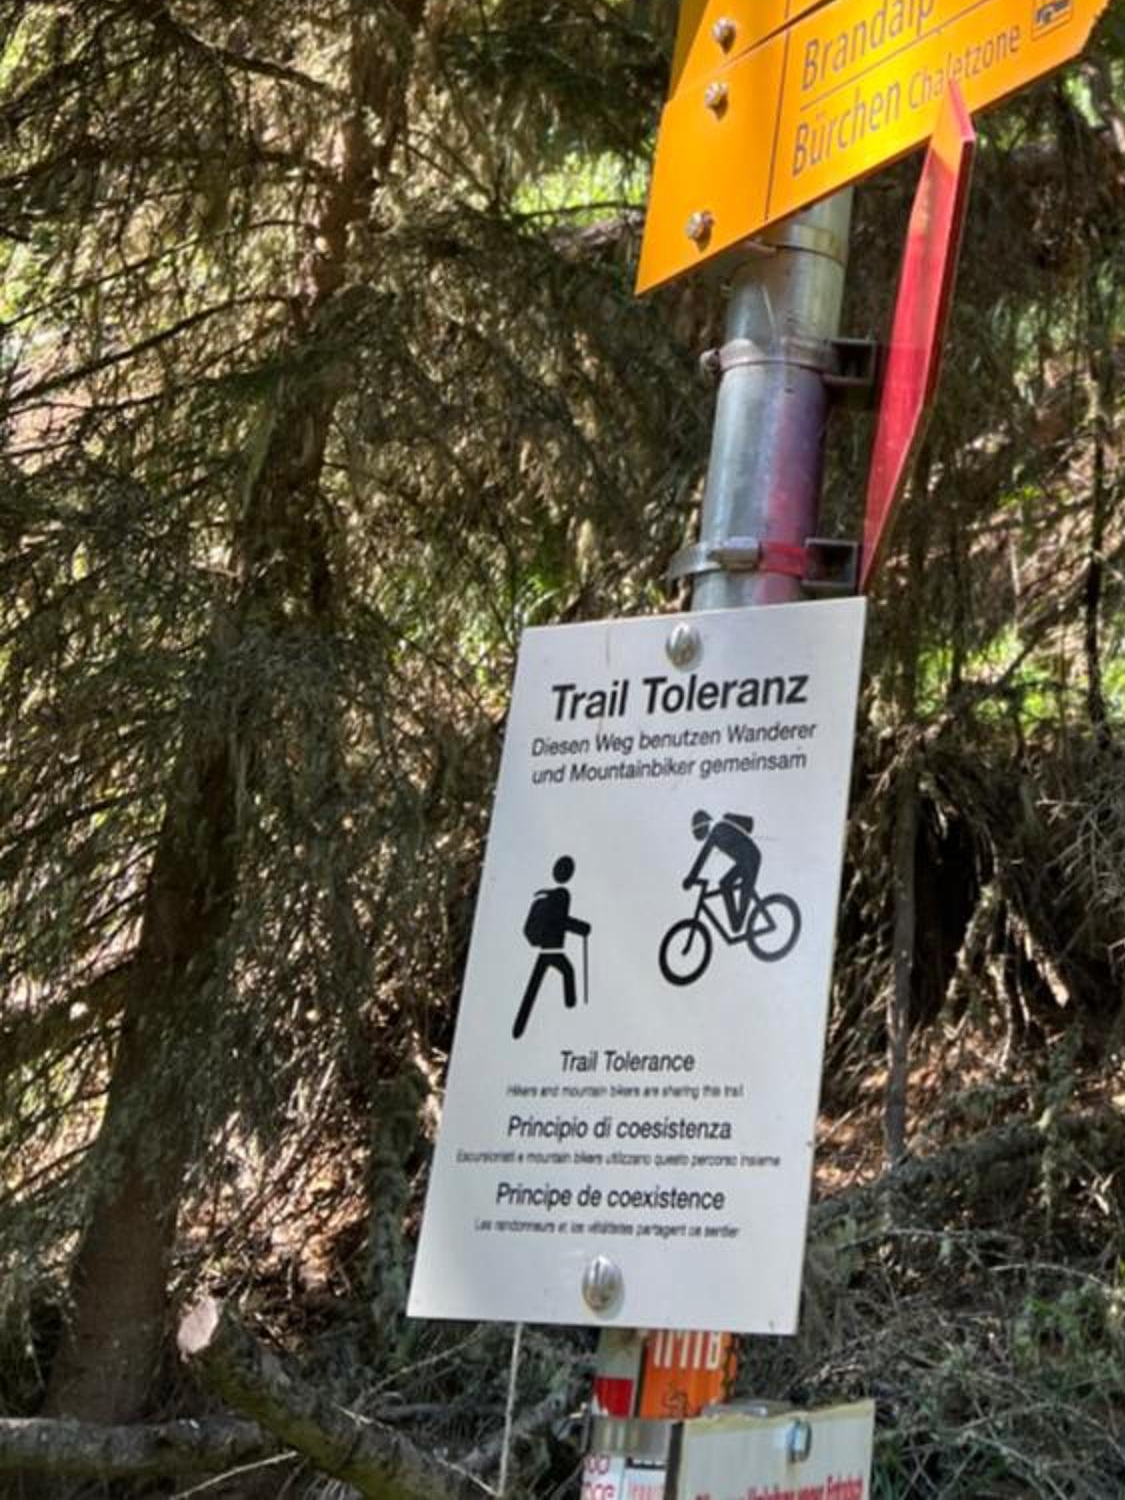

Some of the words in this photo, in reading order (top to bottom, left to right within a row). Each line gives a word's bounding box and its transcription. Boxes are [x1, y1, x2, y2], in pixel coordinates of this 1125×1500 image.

[792, 79, 901, 177] Bürchen
[908, 25, 1021, 109] Chaletzone
[551, 679, 629, 721] Trail
[643, 673, 810, 714] Toleranz
[531, 737, 590, 756] Diesen
[595, 731, 634, 756] Weg
[639, 728, 721, 750] benutzen
[727, 721, 817, 744] Wanderer
[531, 764, 565, 785] und
[570, 756, 696, 781] Mountainbiker
[700, 751, 807, 778] gemeinsam
[560, 1049, 600, 1073] Trail
[604, 1050, 697, 1073] Tolerance
[507, 1115, 589, 1143] Principio
[593, 1116, 613, 1138] di
[616, 1116, 733, 1139] coesistenza
[496, 1182, 573, 1212] Principe
[577, 1183, 603, 1207] de
[606, 1184, 726, 1210] coexistence
